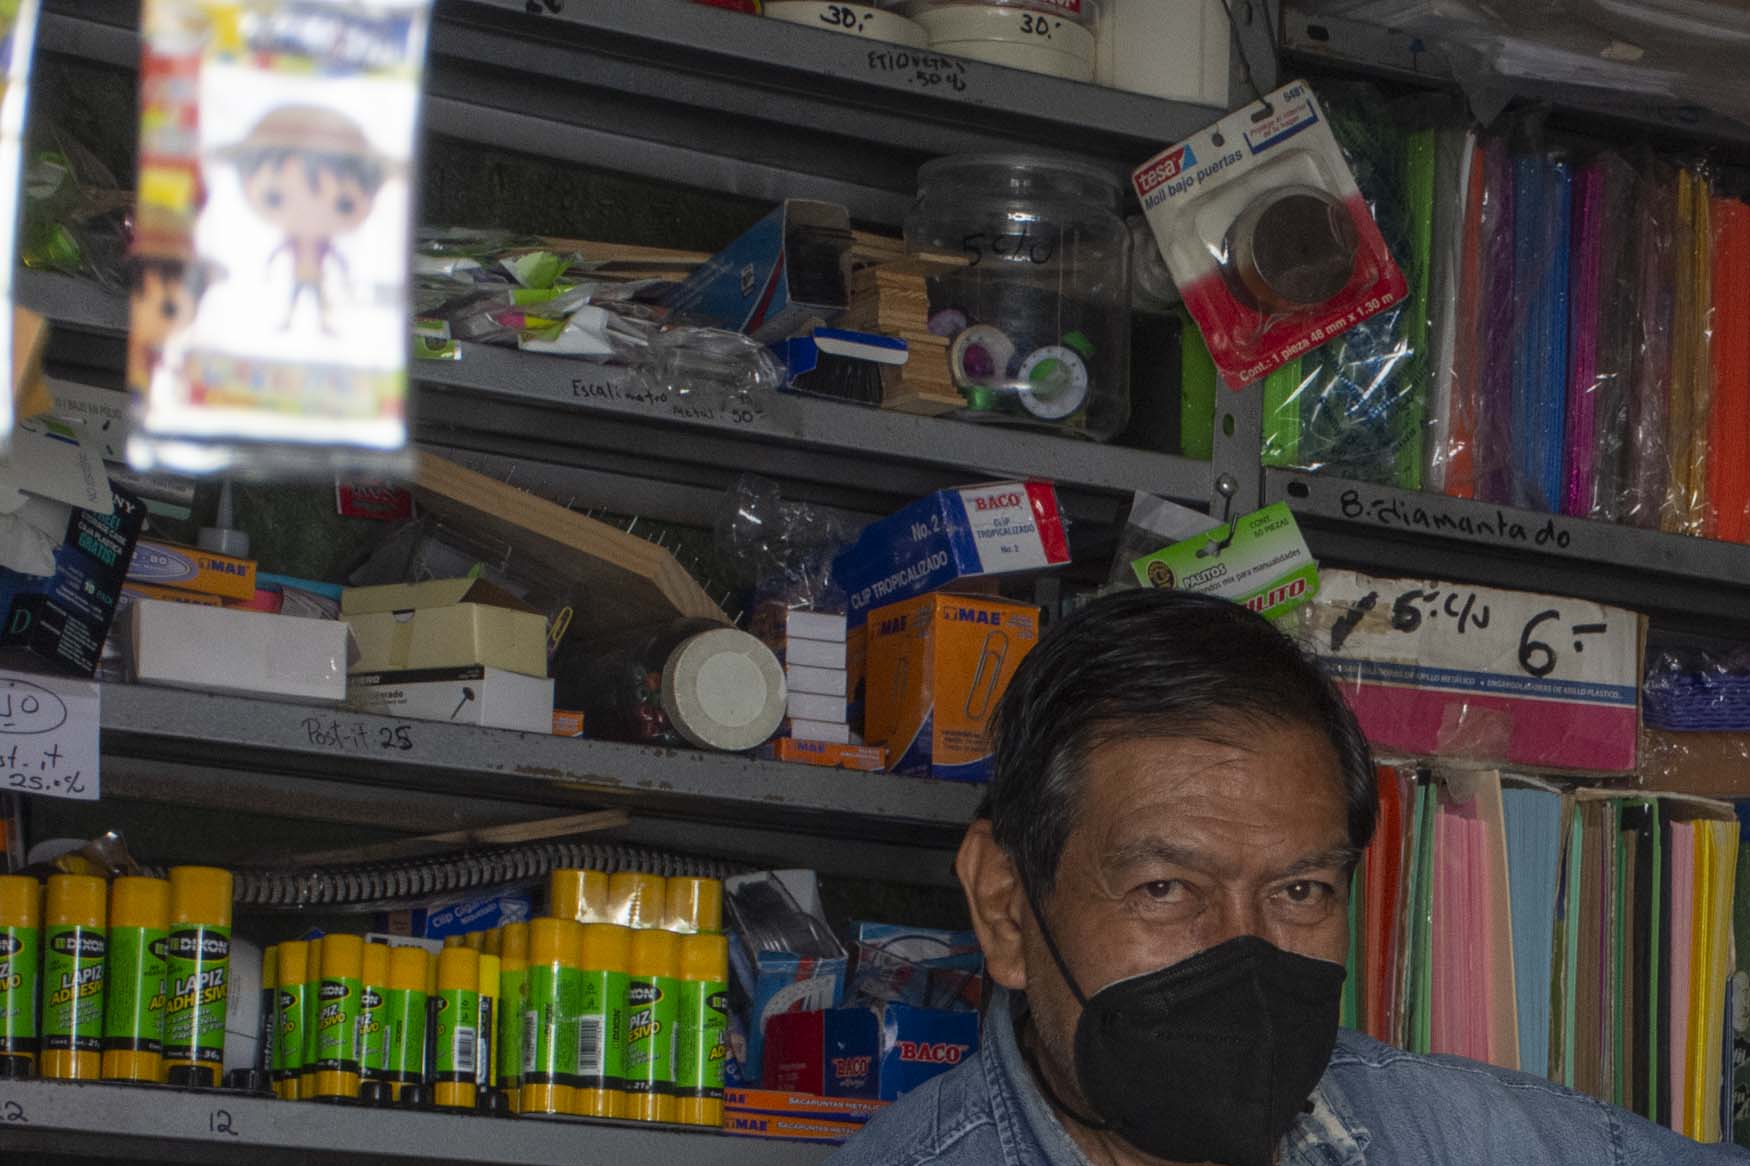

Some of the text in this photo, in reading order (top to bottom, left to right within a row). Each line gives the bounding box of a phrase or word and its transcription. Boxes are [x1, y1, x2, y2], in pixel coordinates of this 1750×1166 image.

[1138, 159, 1177, 192] tesa
[1167, 175, 1195, 199] bajo
[1196, 149, 1244, 186] puertas
[1280, 339, 1311, 363] pieza
[1310, 327, 1325, 344] 48
[1325, 317, 1348, 336] mm
[1356, 297, 1382, 318] 1.30
[1382, 292, 1395, 306] m
[974, 493, 1022, 512] BACO
[931, 513, 943, 533] 2
[976, 522, 1036, 540] TROPICALIZADO
[1252, 547, 1302, 573] manualidades
[850, 549, 949, 611] CLIP TROPICALIZADO
[1182, 562, 1228, 589] PALITOS
[957, 607, 1003, 626] MAE
[179, 937, 229, 955] DIXON
[174, 967, 225, 996] LAPIZ
[899, 1041, 965, 1064] BACO
[832, 1056, 872, 1078] BACO
[208, 1109, 240, 1136] 12
[735, 1119, 770, 1131] MAE
